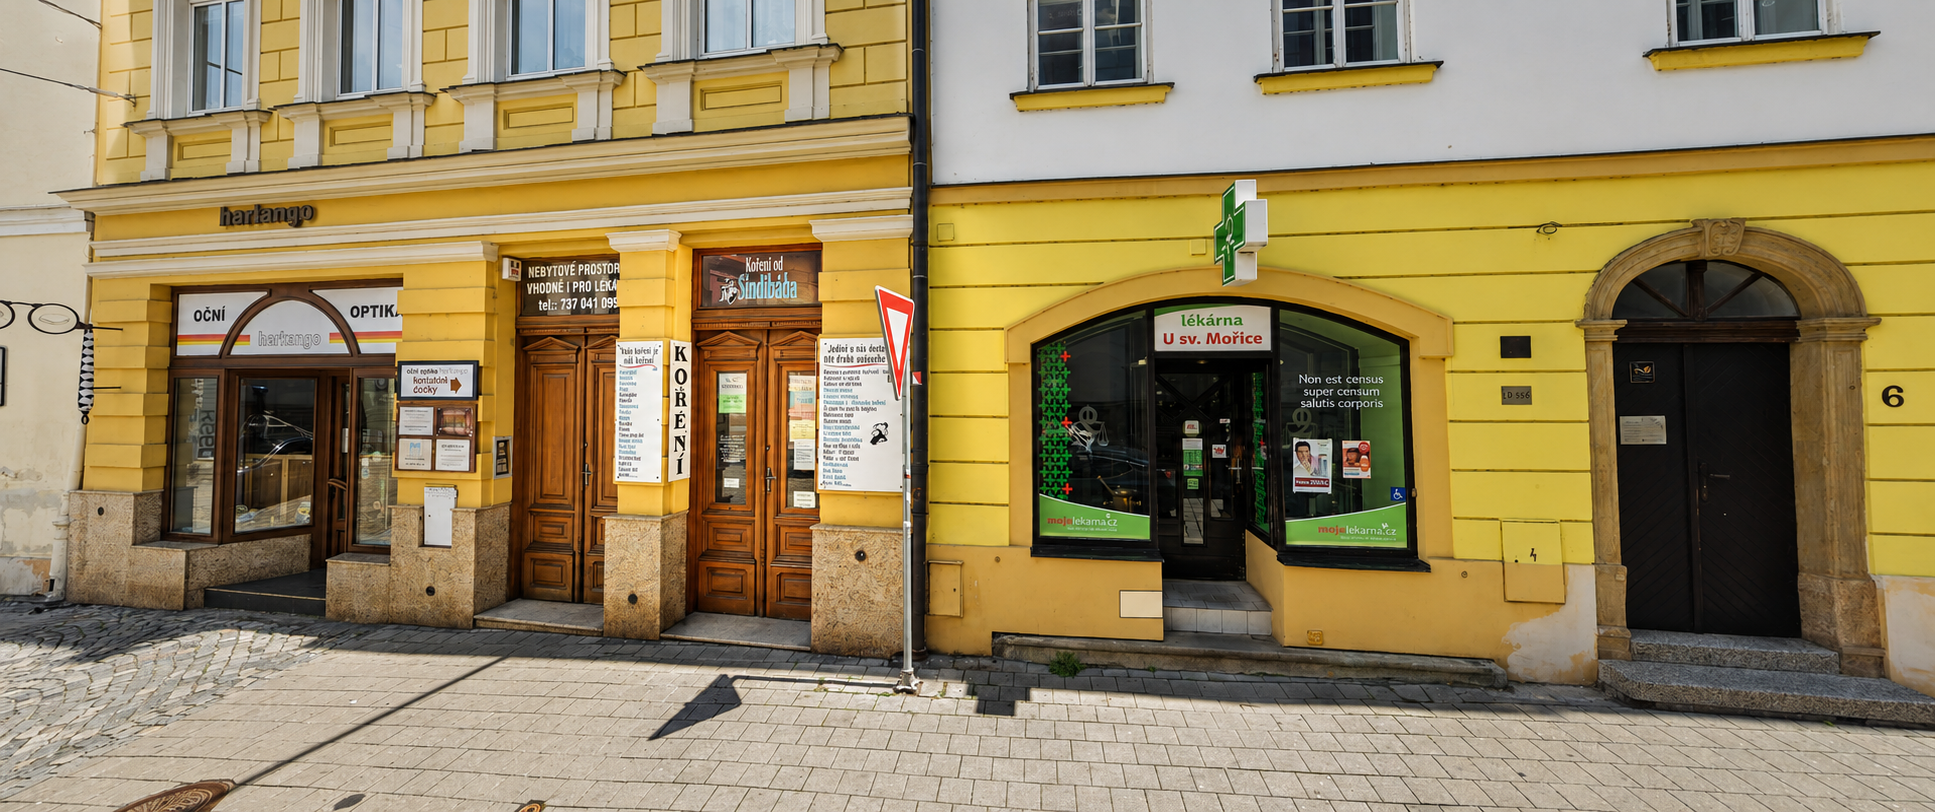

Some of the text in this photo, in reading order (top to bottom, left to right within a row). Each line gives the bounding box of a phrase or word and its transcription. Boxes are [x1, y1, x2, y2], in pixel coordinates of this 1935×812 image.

[528, 261, 576, 279] NEBYTOVÉ
[773, 256, 784, 271] od
[527, 279, 564, 295] VHODNÉ
[567, 281, 570, 293] I
[573, 280, 591, 293] PRO
[561, 298, 578, 310] 737
[581, 297, 597, 309] 041
[194, 306, 225, 322] OČNÍ
[1181, 314, 1244, 327] lékárna
[1163, 331, 1263, 345] U sv. Mořice
[1299, 374, 1384, 384] Non est census
[1303, 388, 1380, 398] super censum
[1882, 385, 1904, 407] 6
[1300, 398, 1384, 410] salutis corporis
